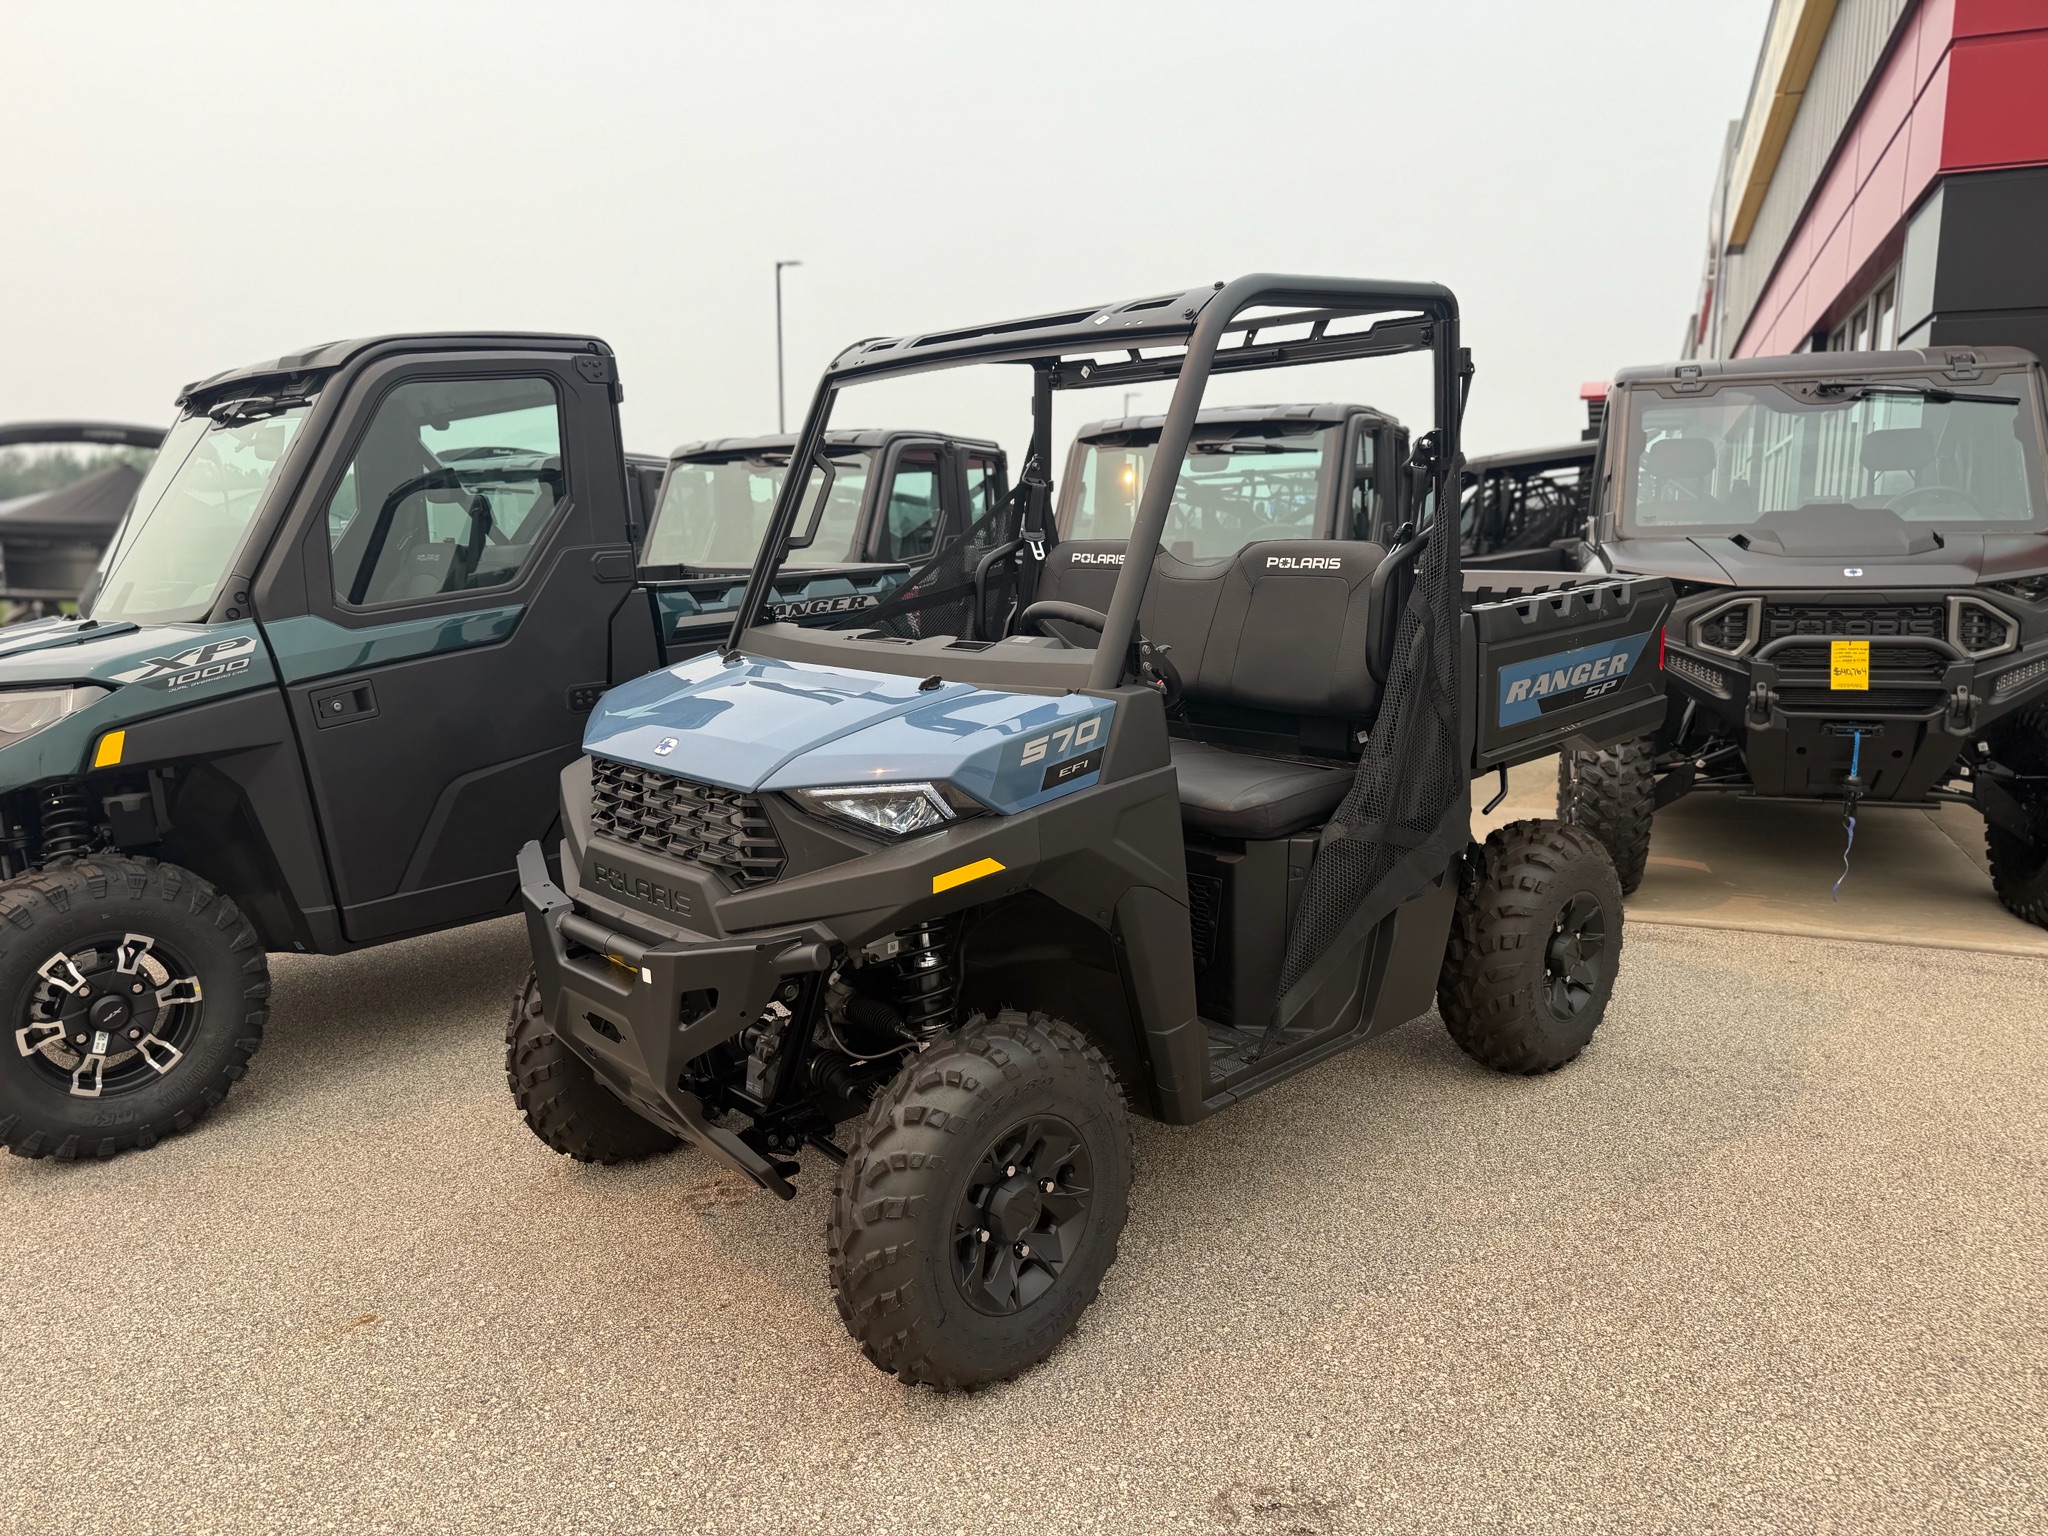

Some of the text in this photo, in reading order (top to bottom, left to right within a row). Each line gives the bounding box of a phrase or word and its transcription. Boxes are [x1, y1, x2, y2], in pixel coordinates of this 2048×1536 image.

[1266, 555, 1342, 570] POLARIS
[773, 595, 869, 618] ANGER
[1769, 619, 1935, 637] POLARIS
[120, 635, 257, 683] XP
[168, 657, 250, 687] 1000
[1505, 652, 1629, 705] RANGER
[168, 684, 189, 693] DUAL
[1583, 679, 1618, 700] SP
[1020, 716, 1101, 767] 570
[1058, 759, 1089, 778] EFI
[594, 862, 692, 918] POLARIS
